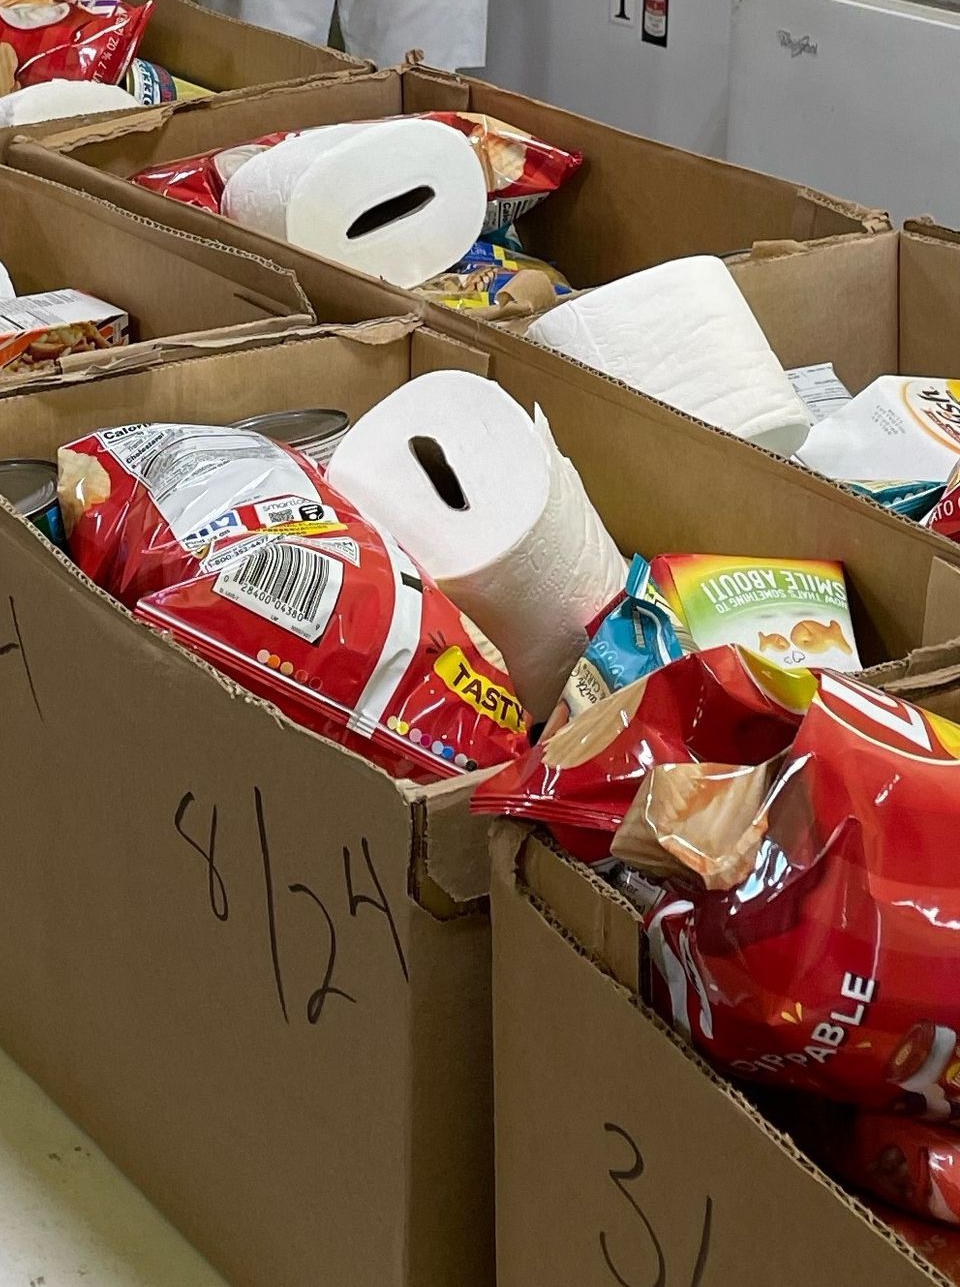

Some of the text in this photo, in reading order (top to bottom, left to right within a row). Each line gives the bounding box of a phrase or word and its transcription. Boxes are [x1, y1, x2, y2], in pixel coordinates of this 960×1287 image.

[106, 37, 120, 52] OZ
[103, 423, 152, 440] Calor
[700, 568, 848, 604] SMILE ABOUT!
[729, 588, 787, 608] SOMETHING
[787, 589, 821, 602] THAT'S
[240, 582, 272, 605] 28400
[274, 601, 304, 622] 04380
[714, 603, 731, 614] TO
[452, 662, 525, 728] TASTY
[174, 785, 410, 1026] 8/24
[730, 971, 876, 1073] DIPPABLE
